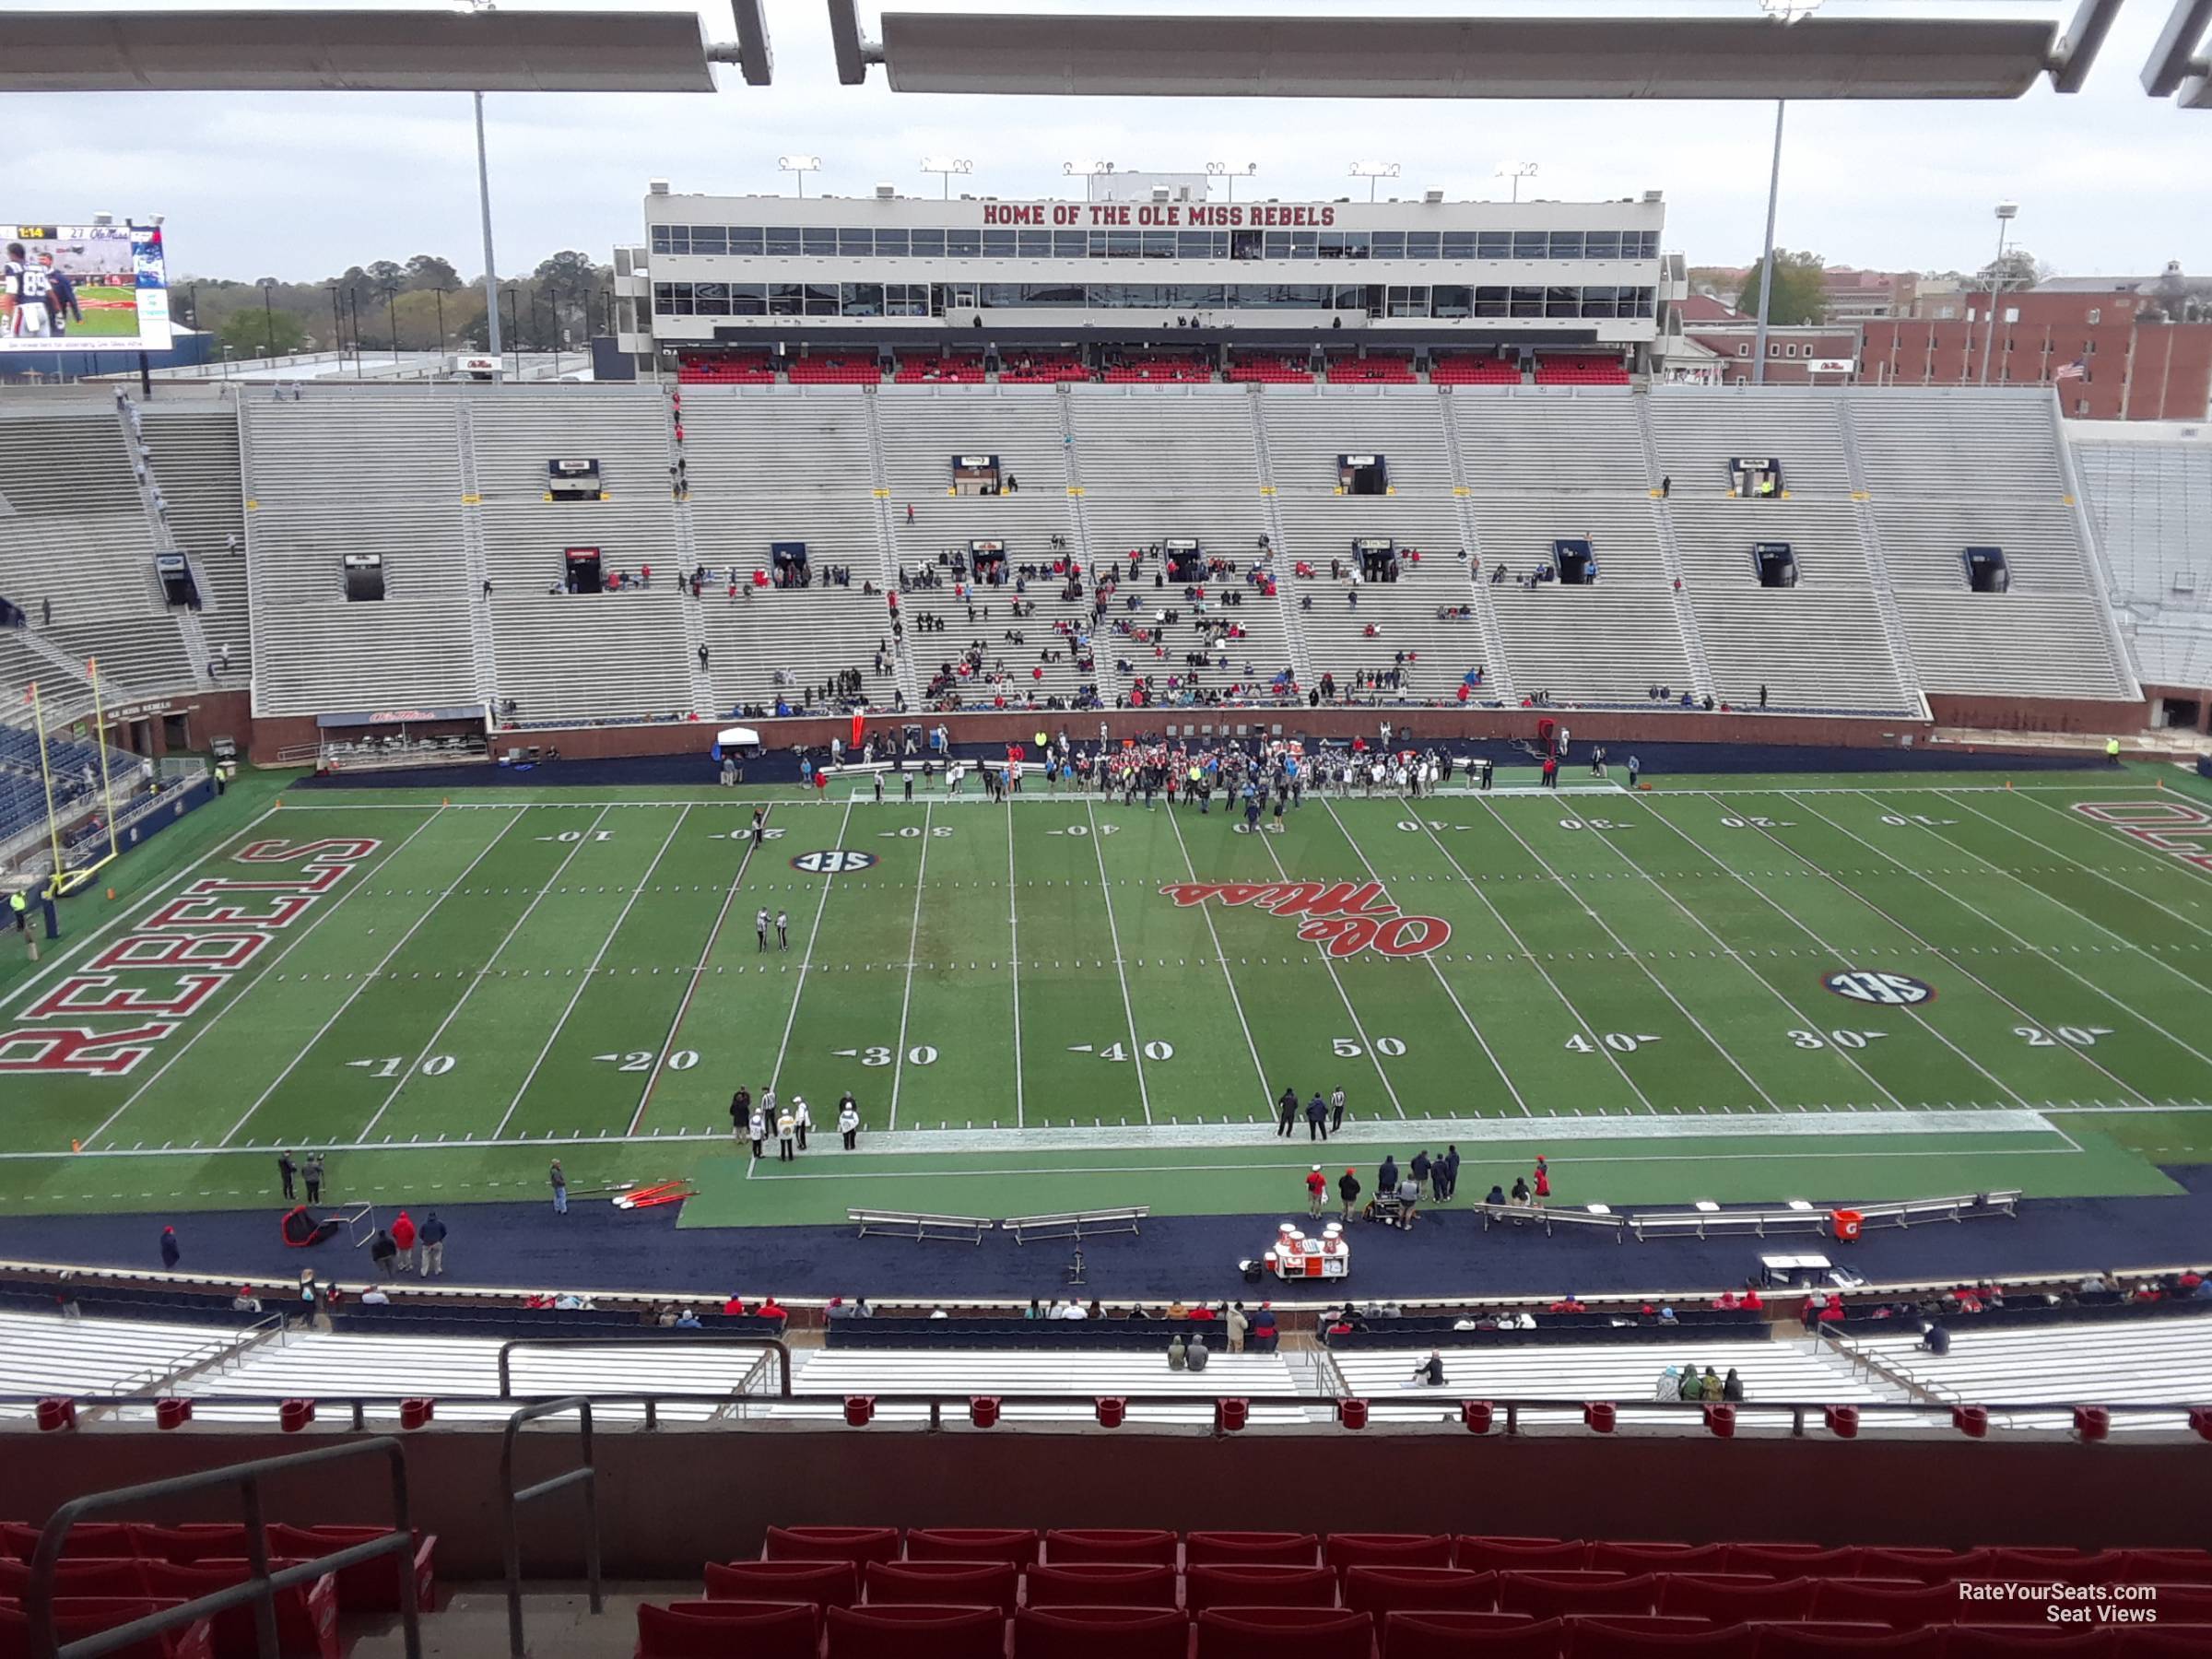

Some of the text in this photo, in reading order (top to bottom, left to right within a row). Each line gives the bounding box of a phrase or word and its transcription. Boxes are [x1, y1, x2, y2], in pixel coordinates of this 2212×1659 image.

[983, 205, 1335, 227] HOME OF THE OLE MISS REBELS
[1158, 881, 1452, 958] Ole Miss
[0, 838, 382, 1077] REBELS
[1830, 971, 1928, 1005] SEC
[1331, 1037, 1407, 1058] 50
[1565, 1032, 1640, 1053] 40
[1786, 1030, 1867, 1050] 30
[2013, 1026, 2098, 1047] 20
[618, 1049, 700, 1072] 20
[862, 1045, 938, 1066] 30
[1099, 1040, 1175, 1063] 40
[367, 1054, 456, 1077] 10
[1846, 1222, 1857, 1234] G
